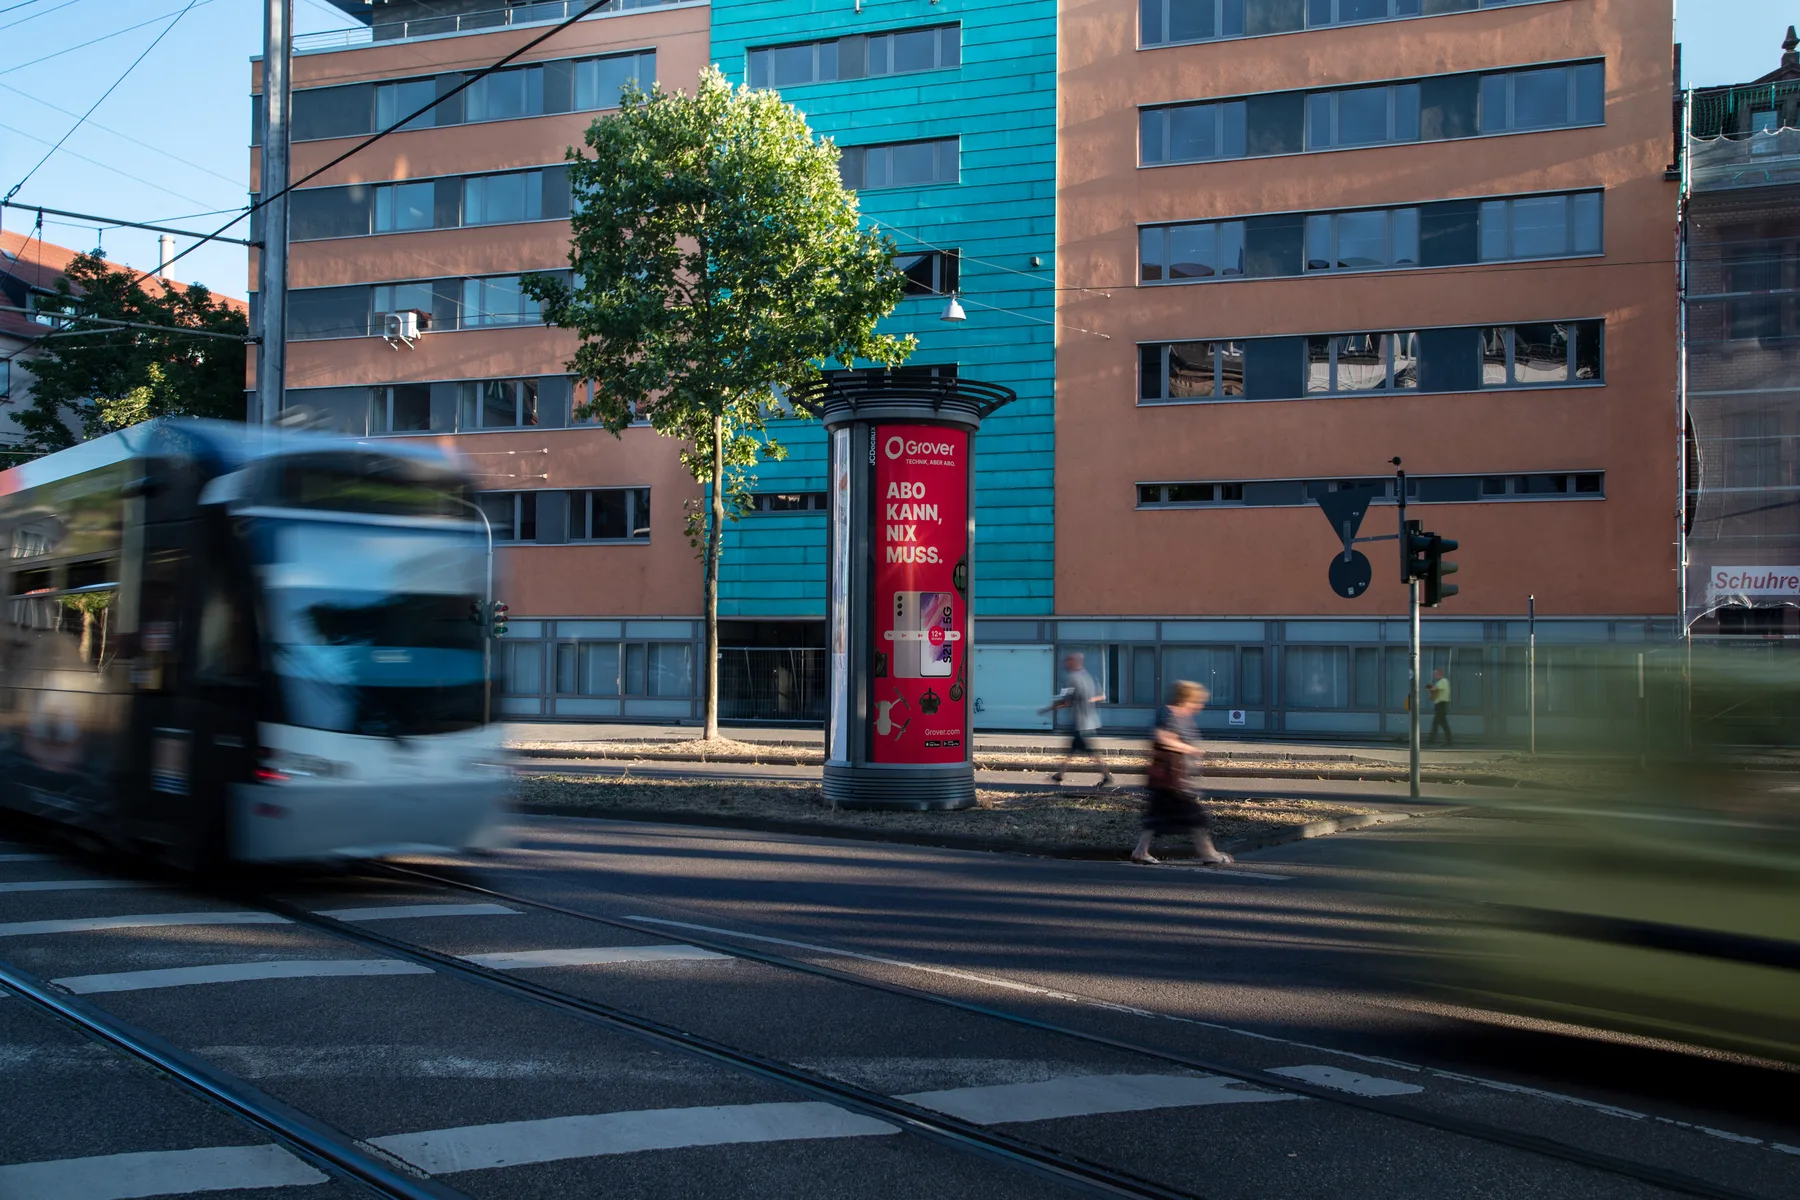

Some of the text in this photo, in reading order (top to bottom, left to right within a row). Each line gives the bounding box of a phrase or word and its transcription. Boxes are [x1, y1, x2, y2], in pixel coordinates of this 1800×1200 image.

[905, 440, 955, 456] Grover
[905, 458, 929, 466] TECHNIK,
[943, 459, 956, 467] ABO.
[886, 481, 926, 499] ABO
[886, 503, 942, 525] KANN,
[886, 524, 917, 542] NIX
[886, 546, 943, 564] MUSS.
[1715, 571, 1800, 594] Schuhre
[943, 606, 952, 625] 5G
[931, 630, 942, 638] 12+
[943, 643, 952, 664] S21
[925, 728, 961, 736] Grover.com
